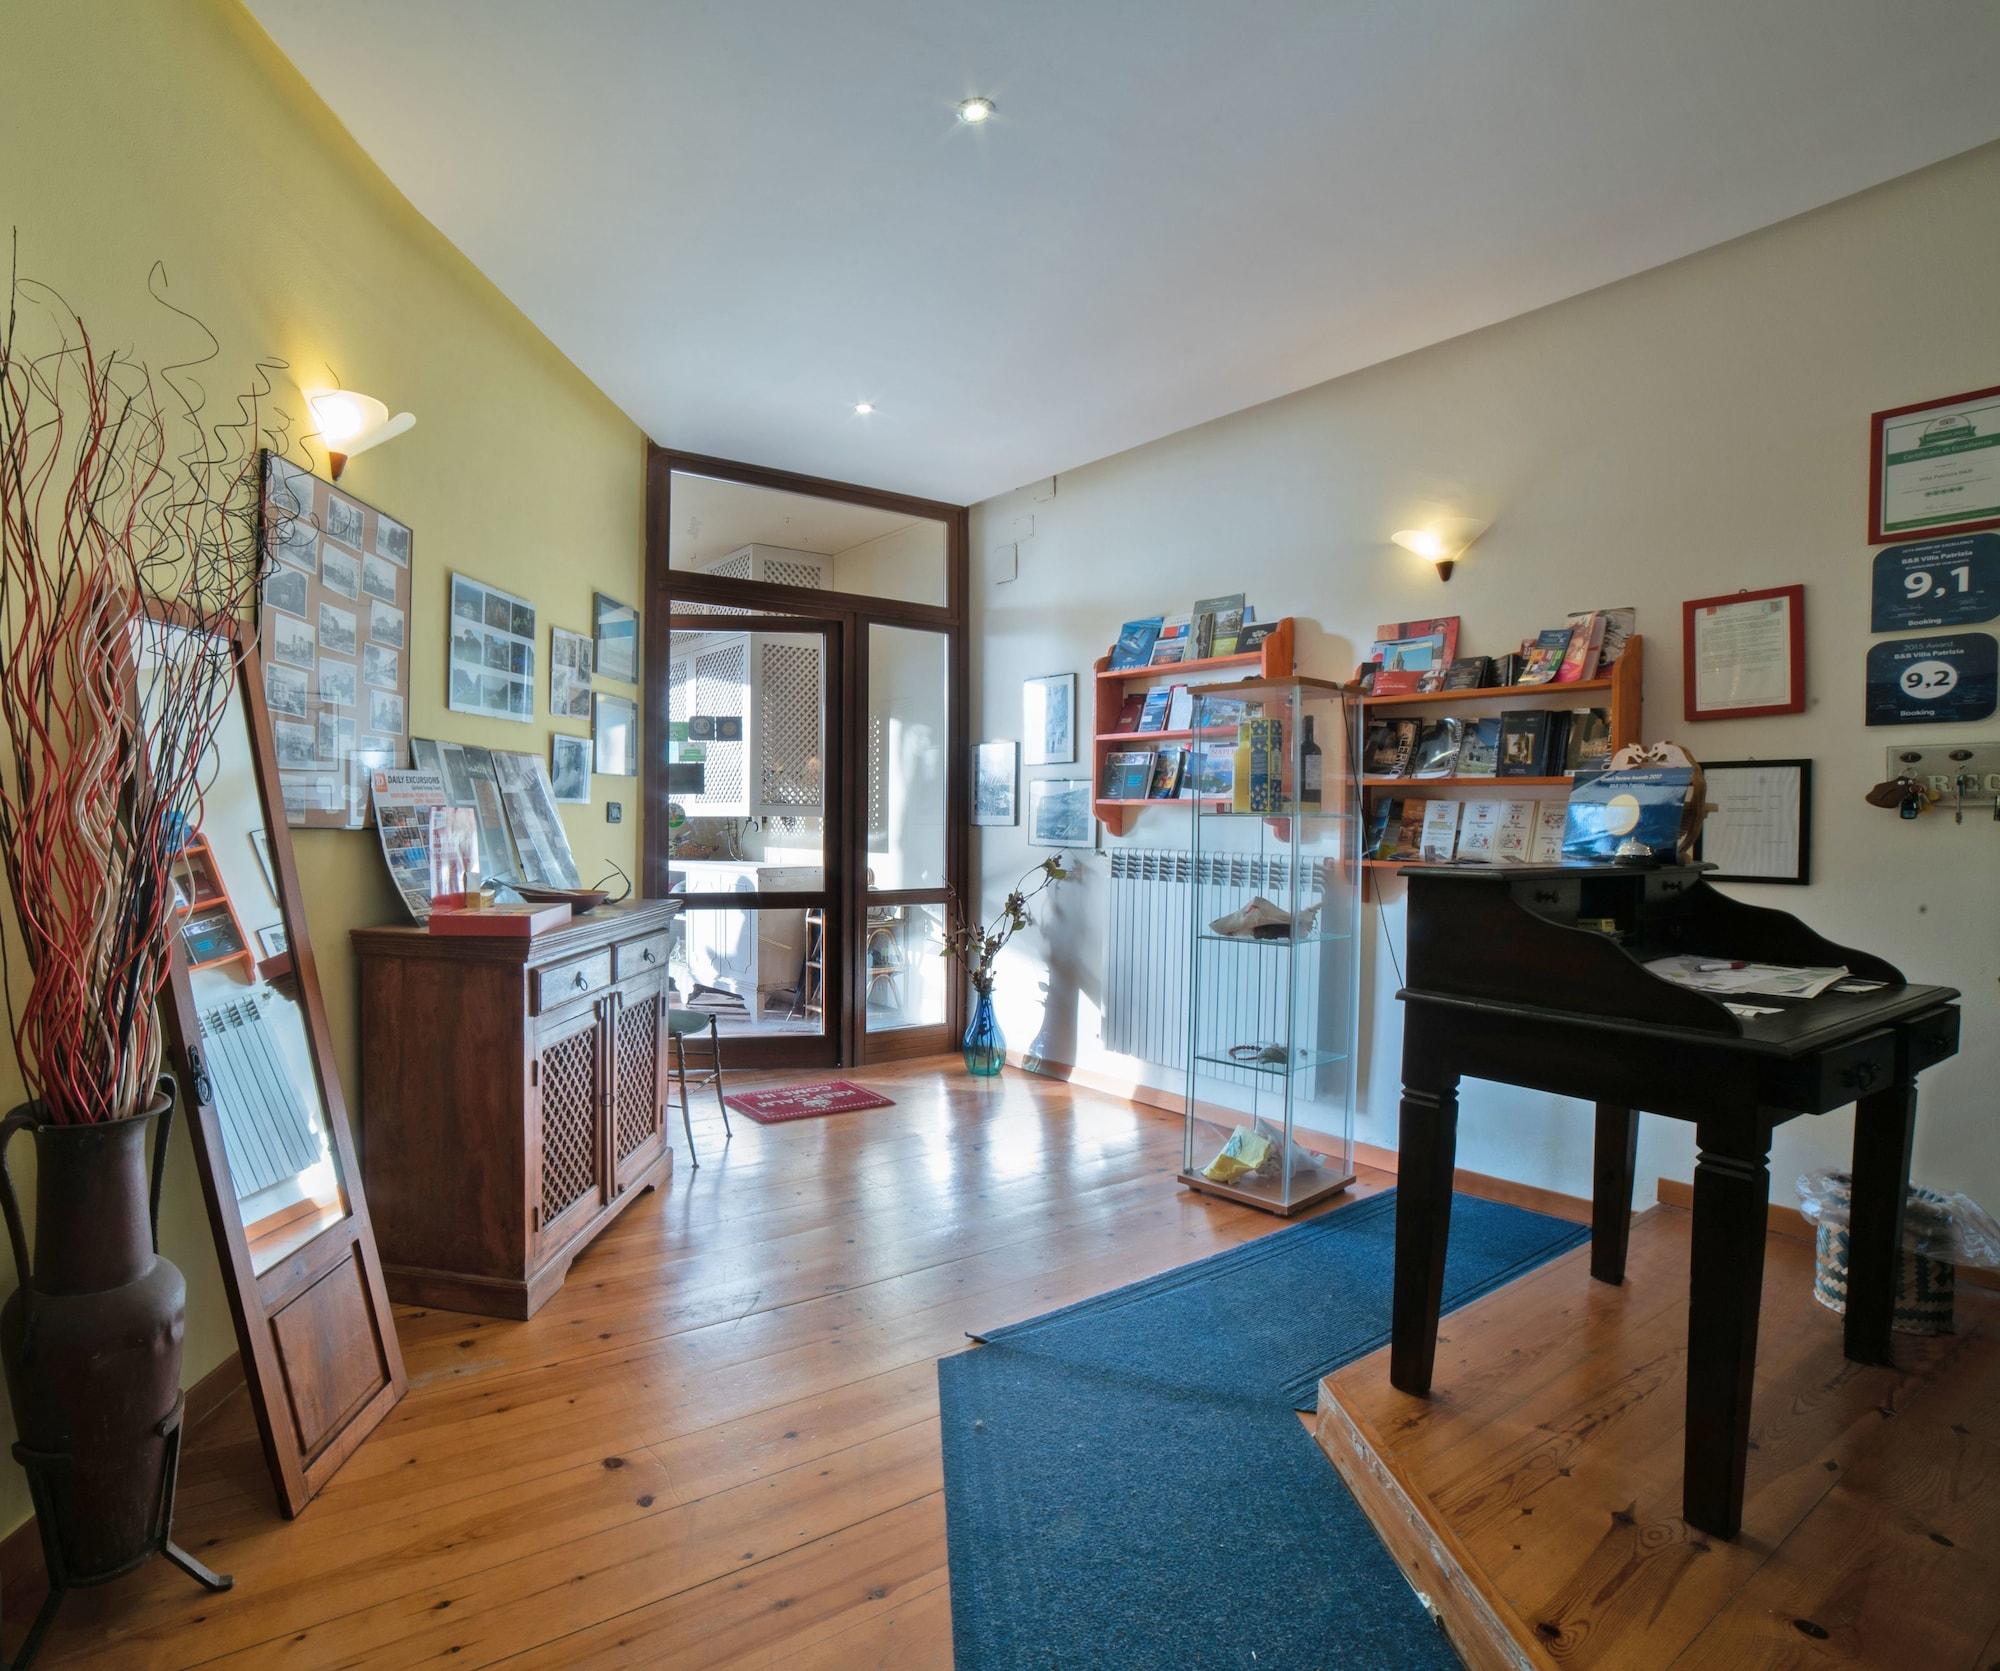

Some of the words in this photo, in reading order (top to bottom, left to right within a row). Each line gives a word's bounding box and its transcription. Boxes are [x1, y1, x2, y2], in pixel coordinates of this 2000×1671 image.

[1921, 553, 1940, 562] Villa
[1941, 550, 1973, 559] Patrizia
[1904, 566, 1969, 599] 9,1
[1904, 643, 1924, 652] 2015
[1926, 641, 1954, 650] Award
[1932, 648, 1965, 657] Patrizia
[388, 775, 404, 785] DAILY
[405, 776, 440, 785] EXCURSIONS
[779, 1085, 832, 1097] COME
[813, 1089, 856, 1100] KEEP
[757, 1098, 808, 1107] CALM
